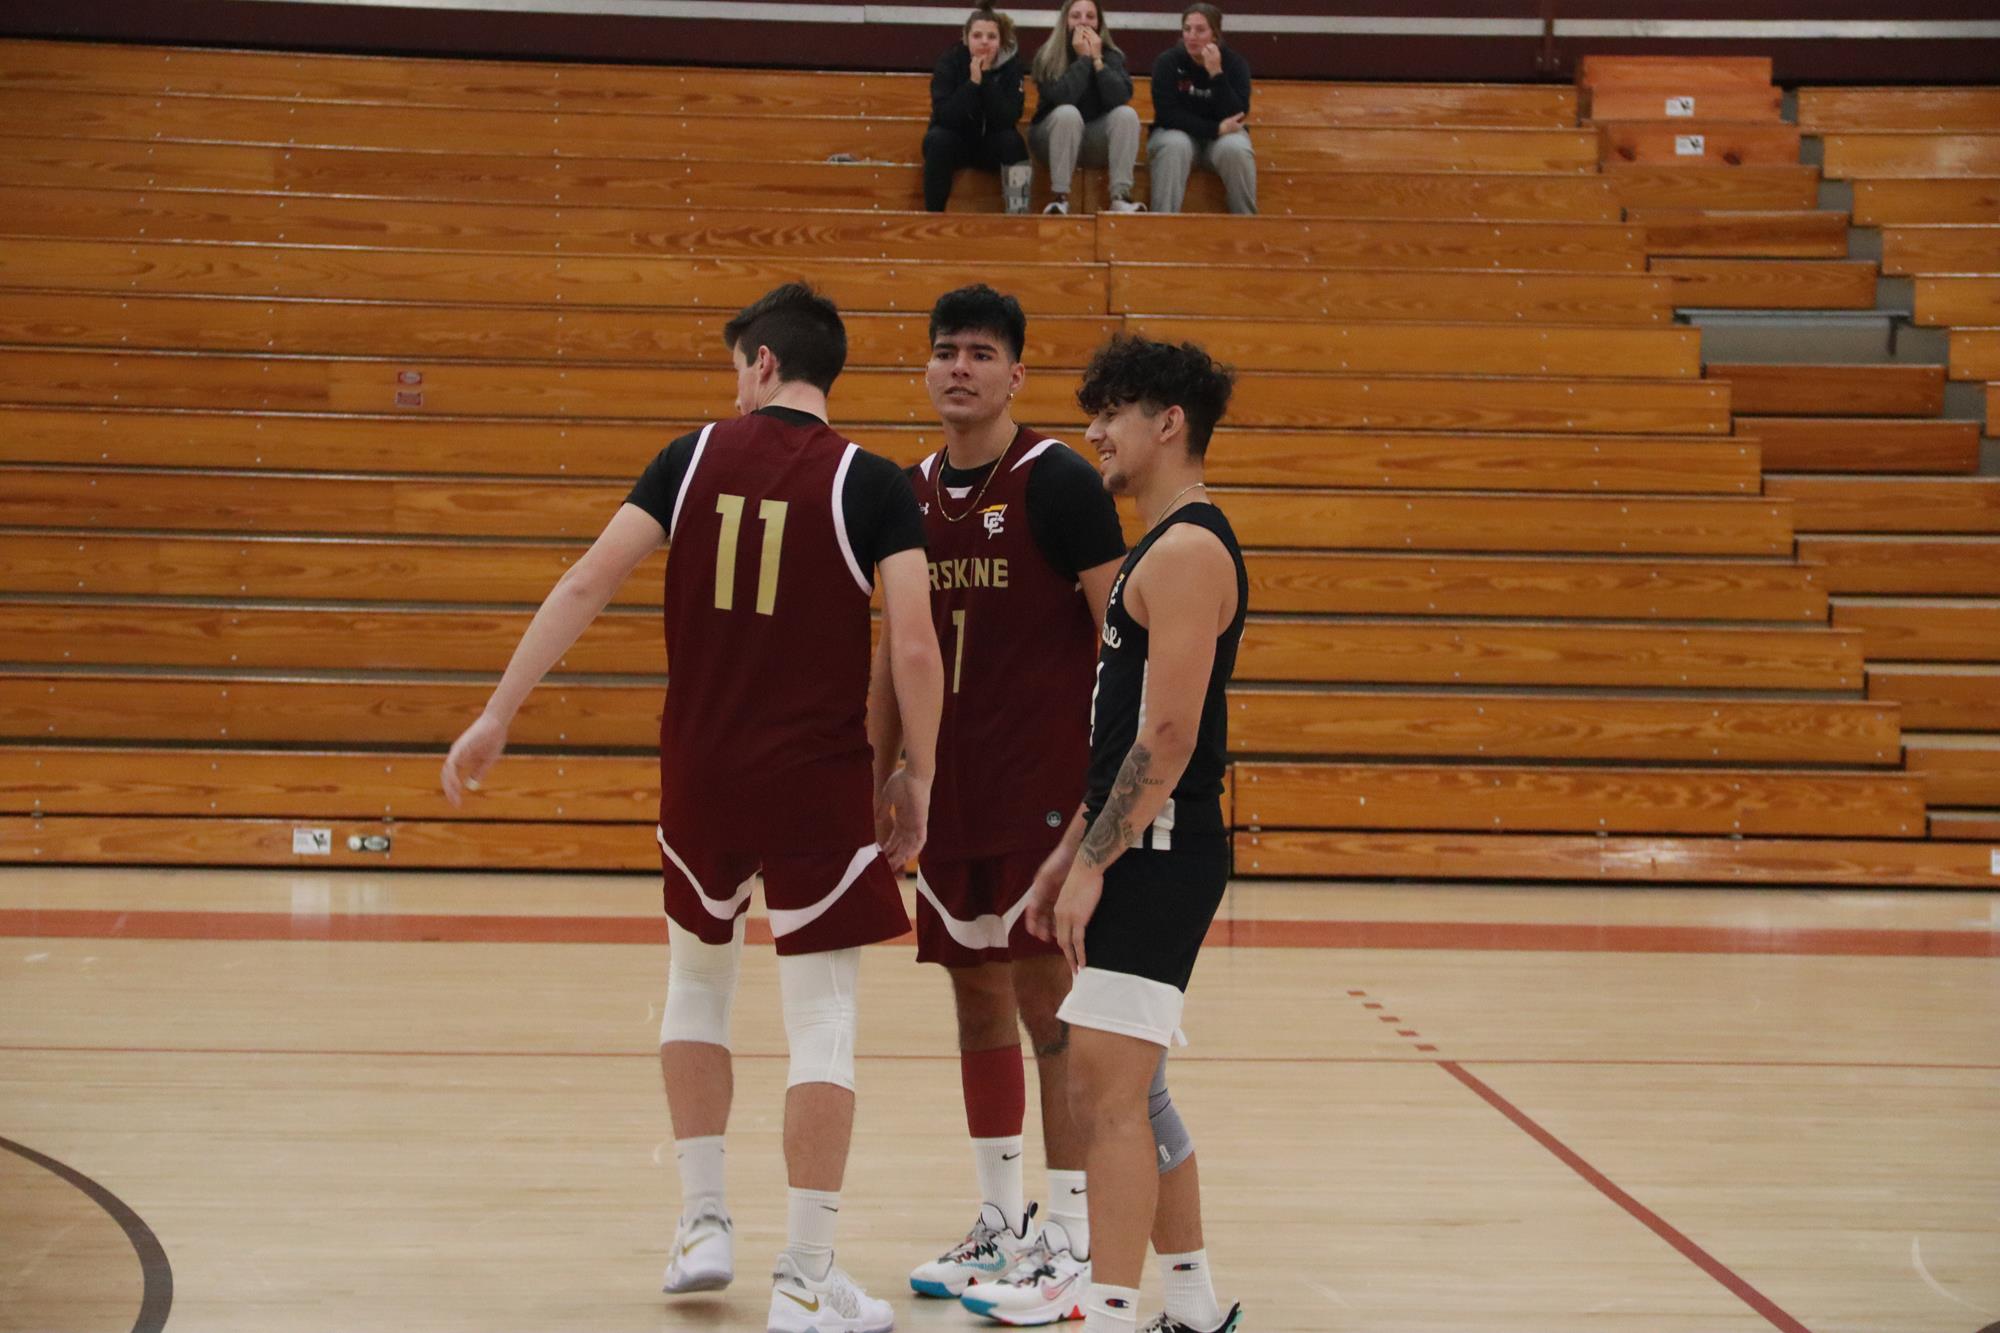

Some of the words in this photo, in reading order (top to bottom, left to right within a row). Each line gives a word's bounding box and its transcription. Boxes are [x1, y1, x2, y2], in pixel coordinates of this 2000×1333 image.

[715, 493, 789, 616] 11
[928, 557, 1009, 591] RSKINE
[952, 610, 966, 694] 1
